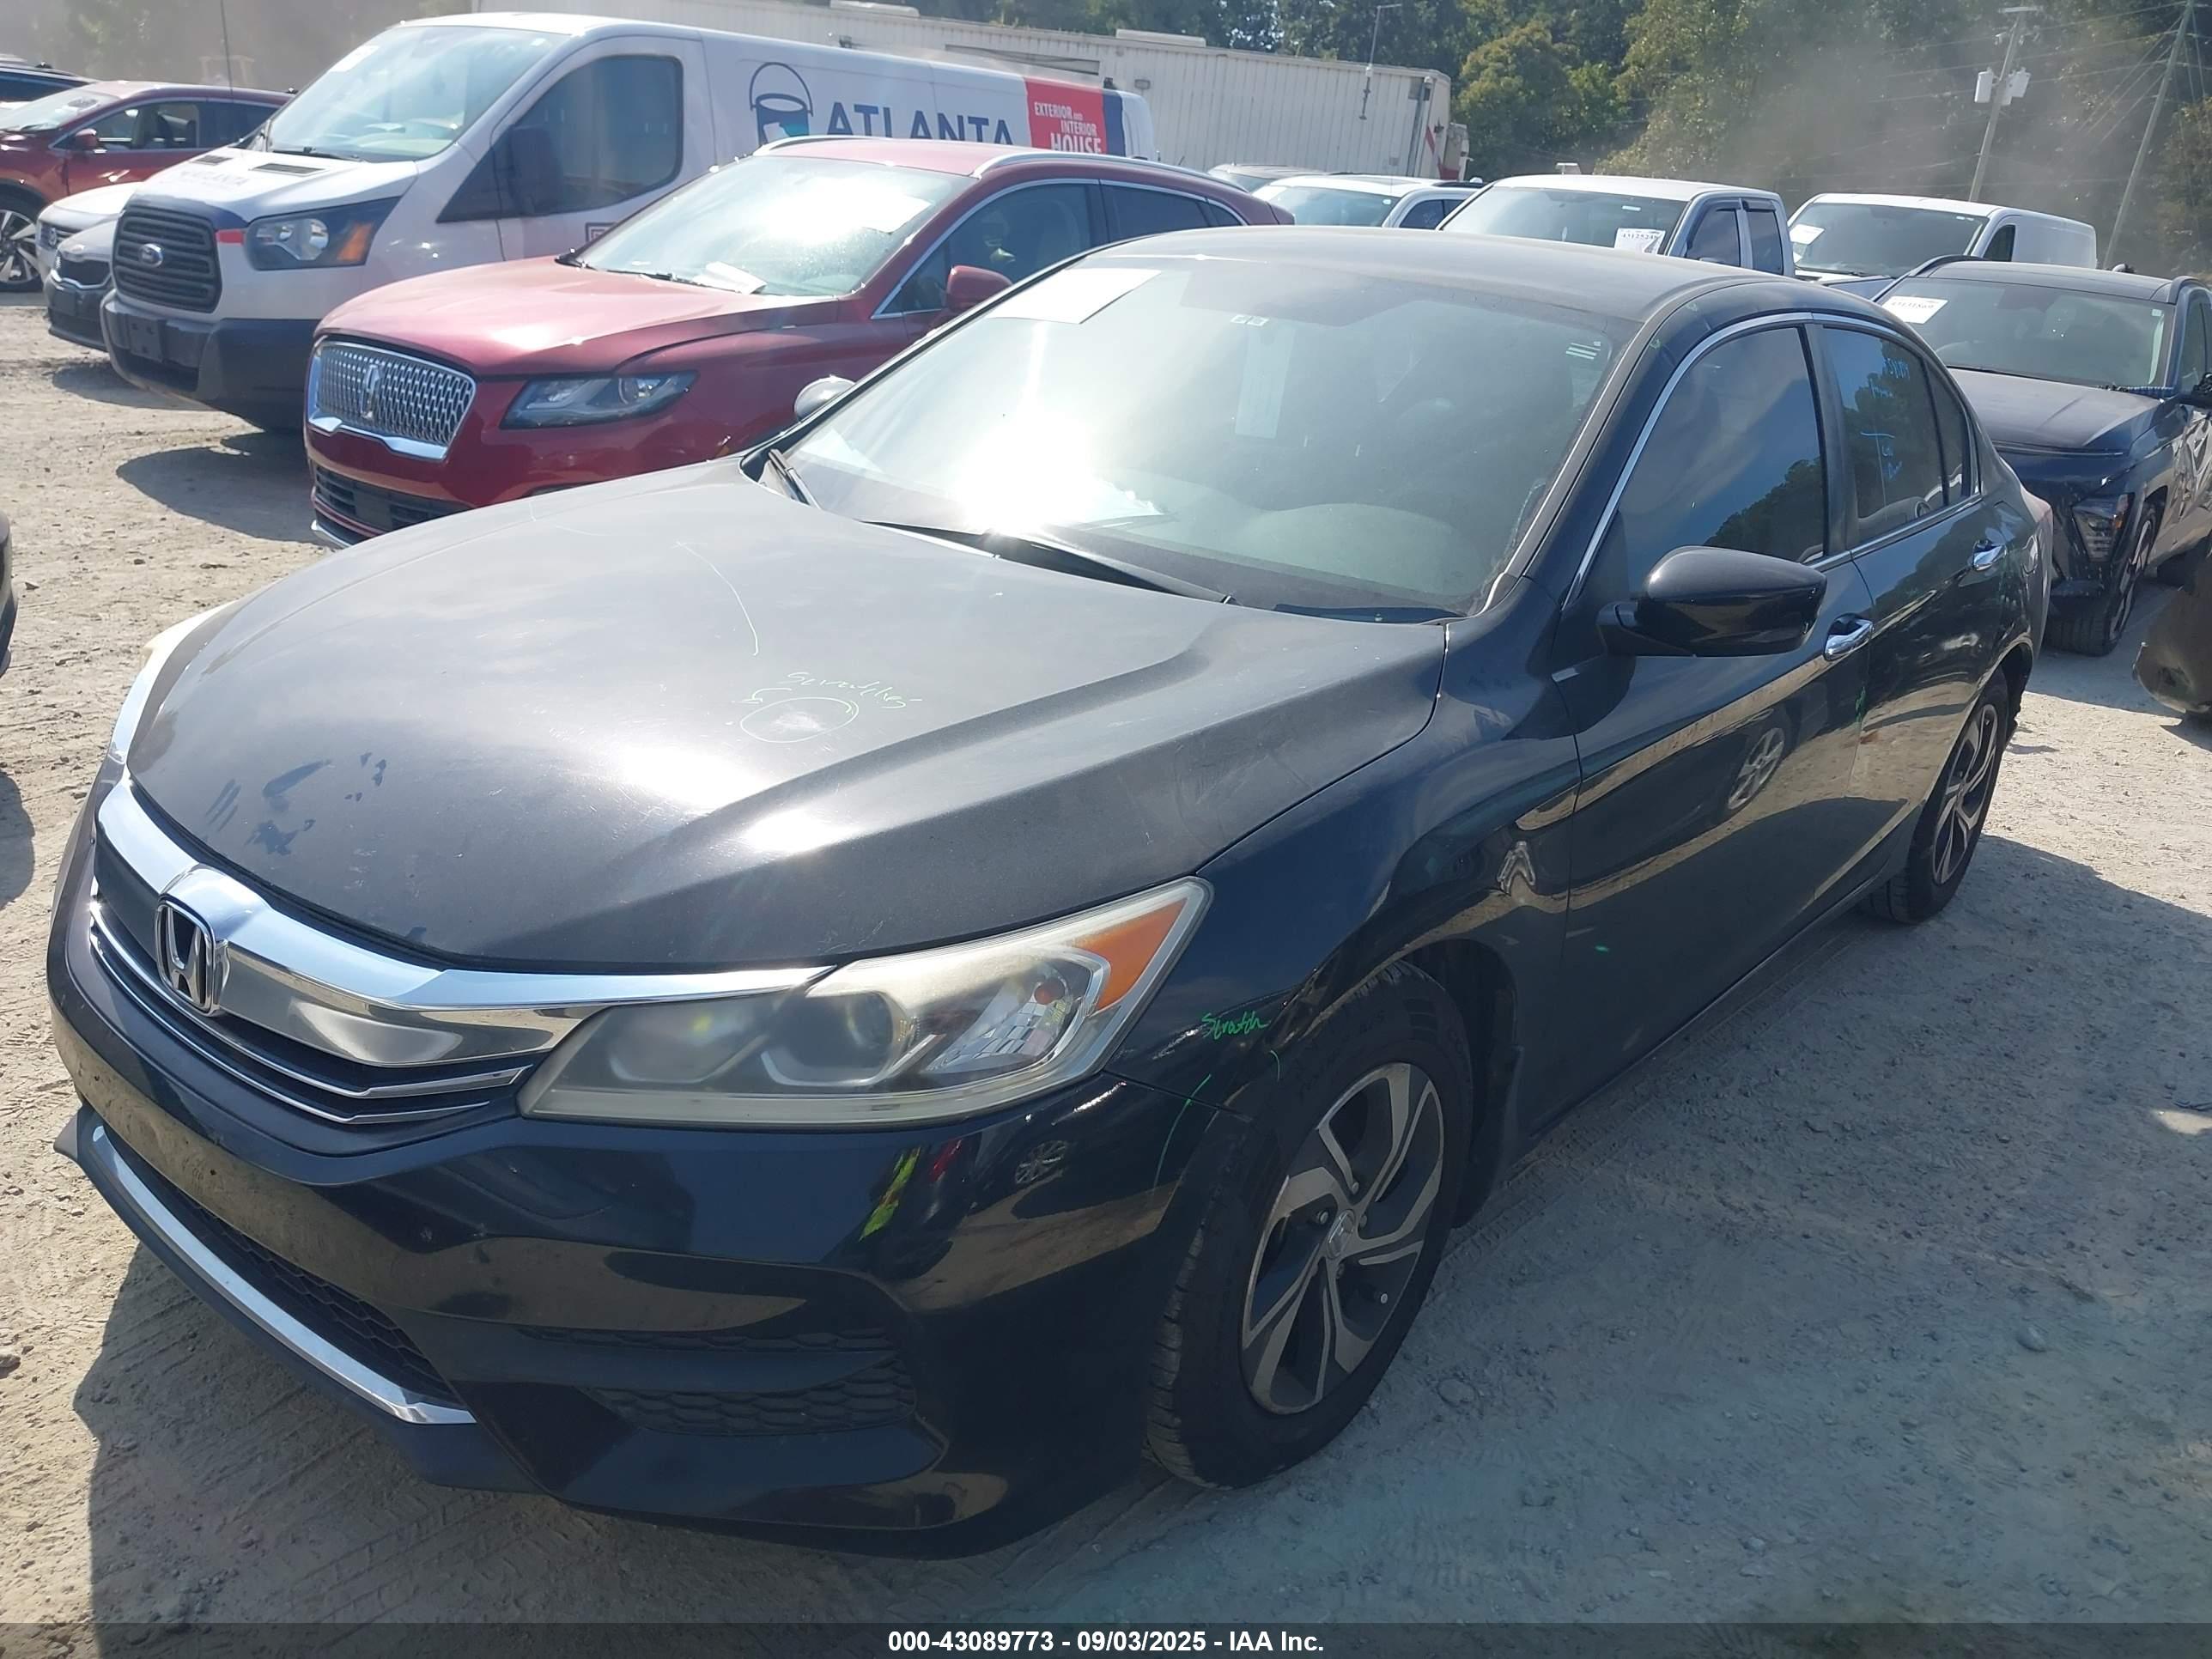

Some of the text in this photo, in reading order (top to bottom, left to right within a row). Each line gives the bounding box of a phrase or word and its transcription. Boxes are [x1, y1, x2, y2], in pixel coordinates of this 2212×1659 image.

[1034, 101, 1073, 120] EXTERIOR
[827, 102, 1013, 145] ATLANTA
[1060, 119, 1098, 137] INTERIOR
[1050, 132, 1102, 154] HOUSE
